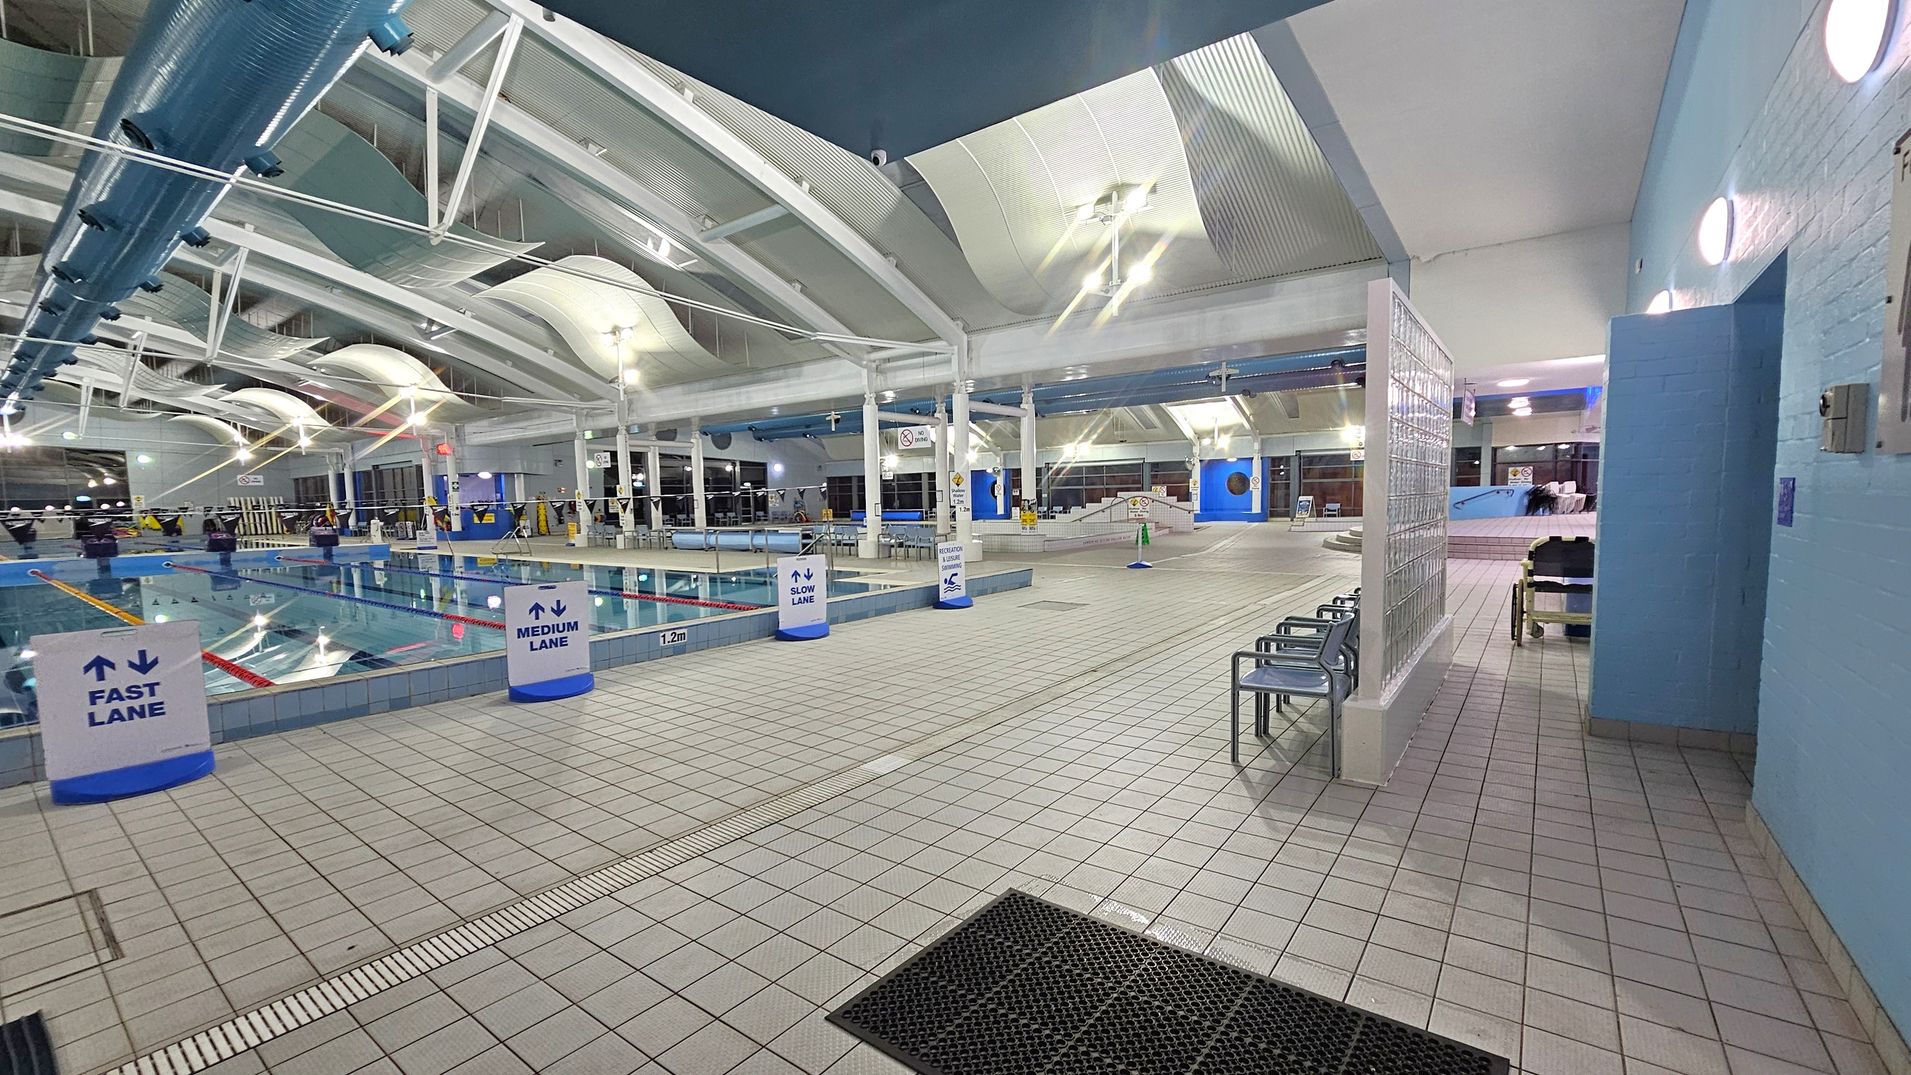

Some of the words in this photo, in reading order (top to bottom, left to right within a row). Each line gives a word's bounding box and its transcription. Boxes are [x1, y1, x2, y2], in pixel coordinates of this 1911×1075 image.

[939, 545, 963, 554] RECREATION
[946, 554, 961, 562] LEISURE
[941, 562, 962, 571] SWIMMING
[790, 584, 816, 596] SLOW
[791, 595, 815, 606] LANE
[516, 620, 579, 639] MEDIUM
[529, 636, 569, 652] LANE
[660, 631, 687, 645] 1.2m
[88, 681, 161, 706] FAST
[87, 701, 166, 728] LANE
